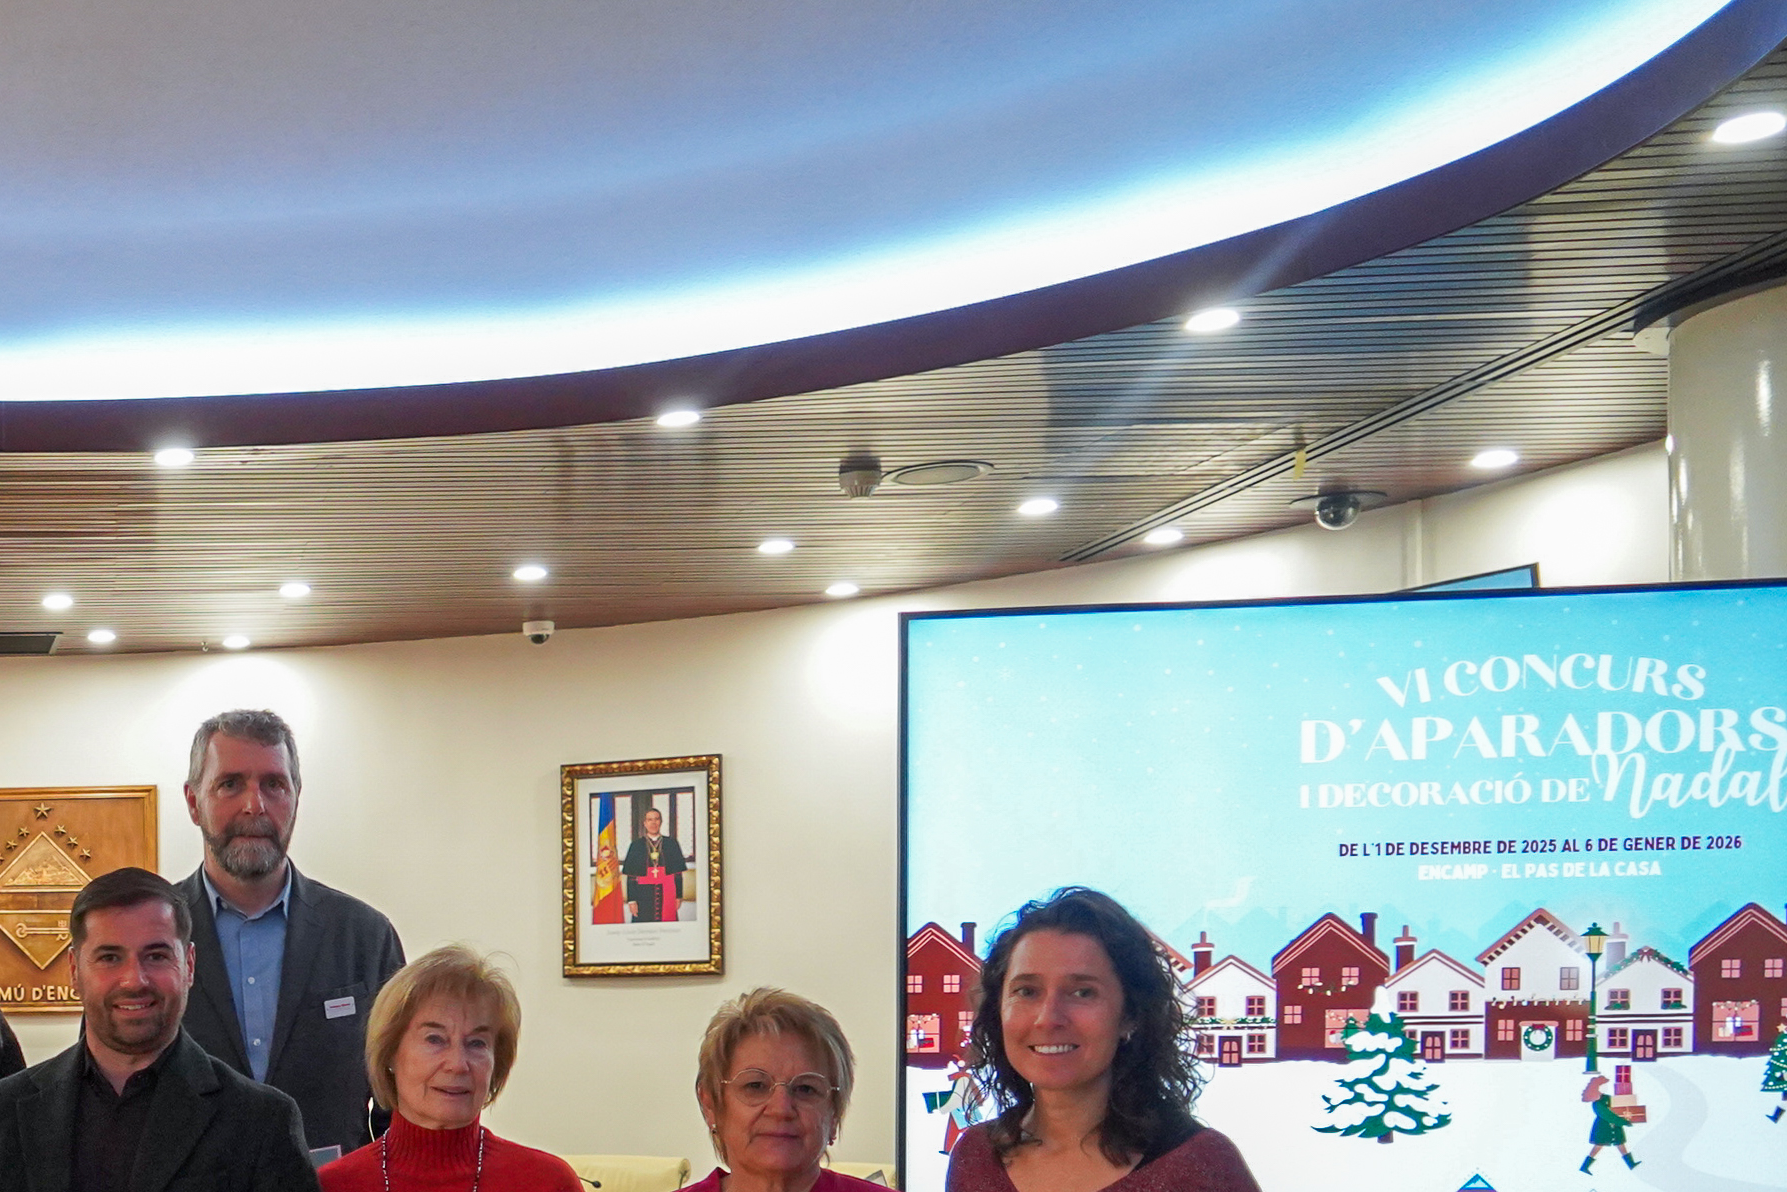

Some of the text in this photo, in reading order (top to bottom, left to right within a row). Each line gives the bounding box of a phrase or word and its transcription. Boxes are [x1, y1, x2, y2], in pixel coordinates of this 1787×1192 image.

[1376, 653, 1706, 708] VI CONCURS
[1299, 741, 1787, 819] I DECORACIÓ DE Nadal
[1339, 843, 1358, 856] DE
[1385, 842, 1405, 856] DE
[1409, 840, 1492, 855] DESEMBRE
[1496, 840, 1516, 854] DE
[1521, 839, 1557, 853] 2025
[1561, 839, 1580, 852] AL
[1585, 838, 1593, 852] 6
[1598, 838, 1618, 851] DE
[1623, 836, 1676, 851] GENER
[1680, 836, 1701, 850] DE
[1706, 835, 1742, 849] 2026
[1418, 864, 1488, 880] ENCAMP
[1501, 863, 1521, 878] EL
[1525, 863, 1559, 878] PAS
[1563, 862, 1585, 877] DE
[1589, 862, 1610, 877] LA
[1614, 861, 1662, 876] CASA
